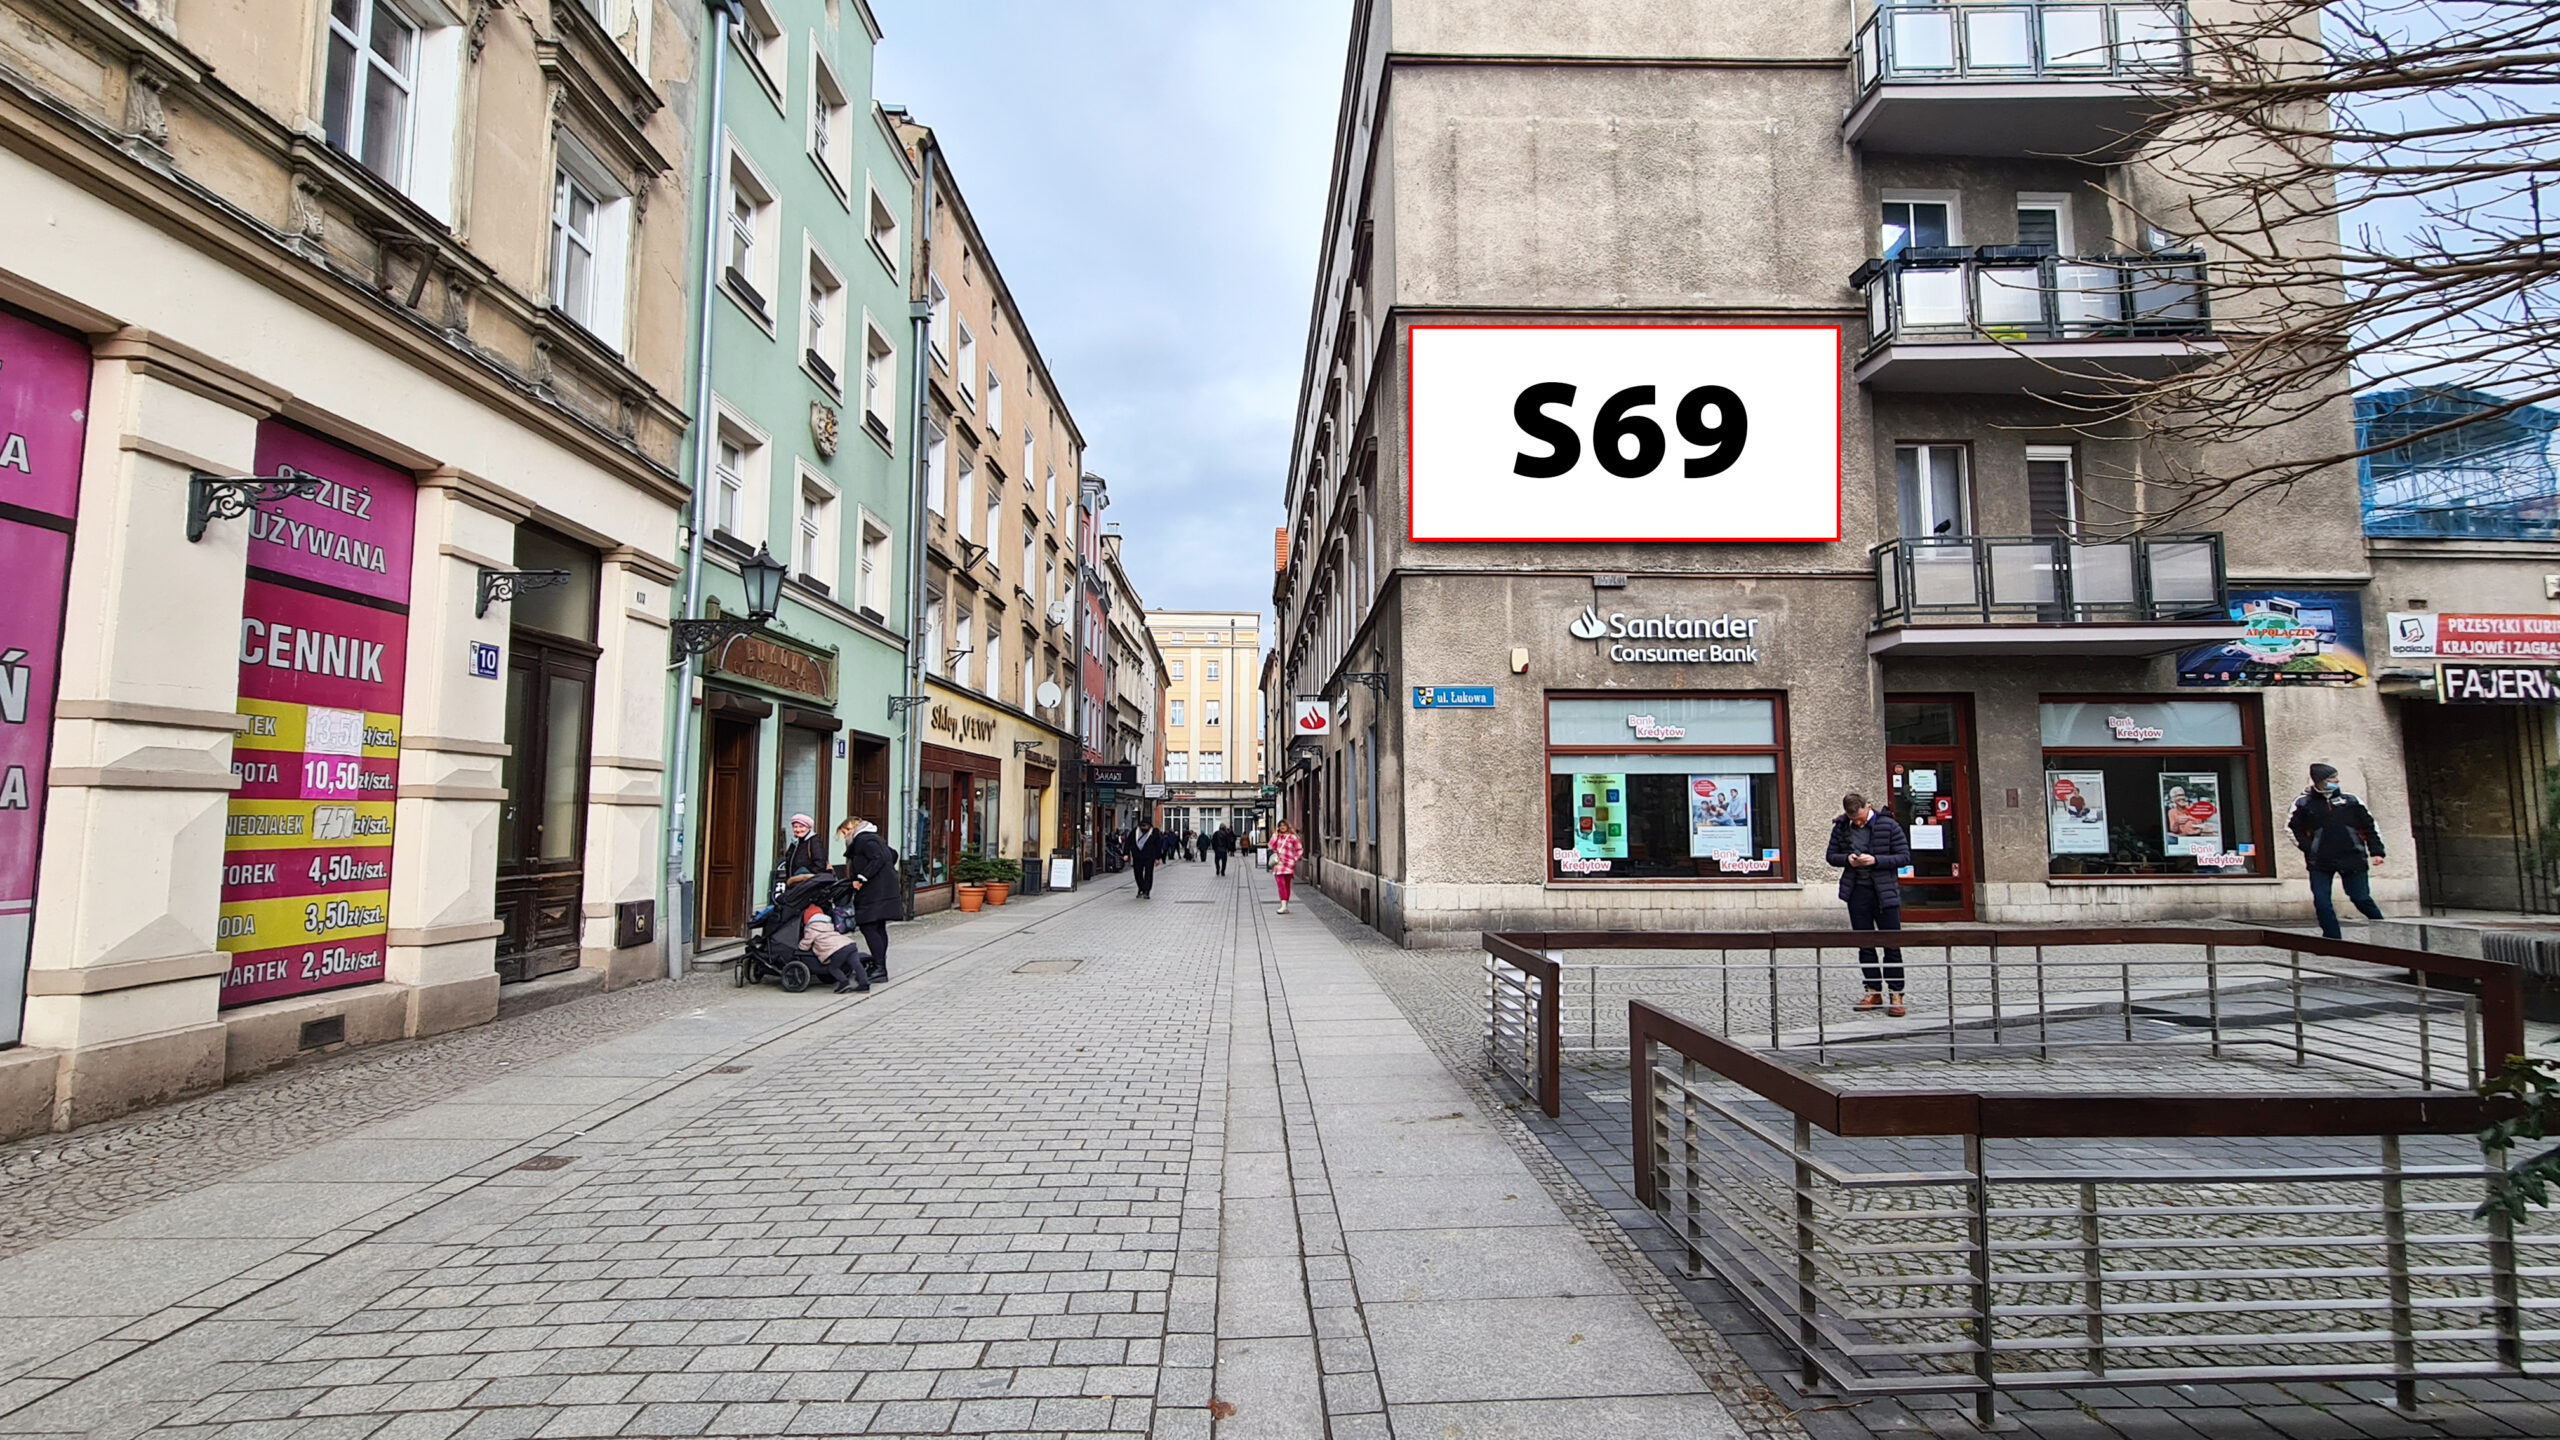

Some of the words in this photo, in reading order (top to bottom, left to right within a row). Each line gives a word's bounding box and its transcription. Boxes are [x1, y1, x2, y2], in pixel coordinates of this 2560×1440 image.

[249, 508, 387, 575] UŻYWANA
[1609, 613, 1758, 639] Santander
[2448, 618, 2520, 633] PRZESYŁKI
[239, 616, 384, 684] CENNIK
[1610, 644, 1708, 662] Consumer
[1709, 644, 1758, 662] Bank
[2442, 641, 2504, 655] KRAJOWE
[479, 649, 496, 672] 10
[1437, 691, 1449, 704] ul.
[1451, 691, 1487, 704] Łukowa
[931, 704, 958, 740] Sklep
[1629, 716, 1653, 726] Bank
[2109, 717, 2133, 727] Bank
[1555, 849, 1580, 859] Bank
[1713, 849, 1738, 859] Bank
[2191, 844, 2213, 854] Bank
